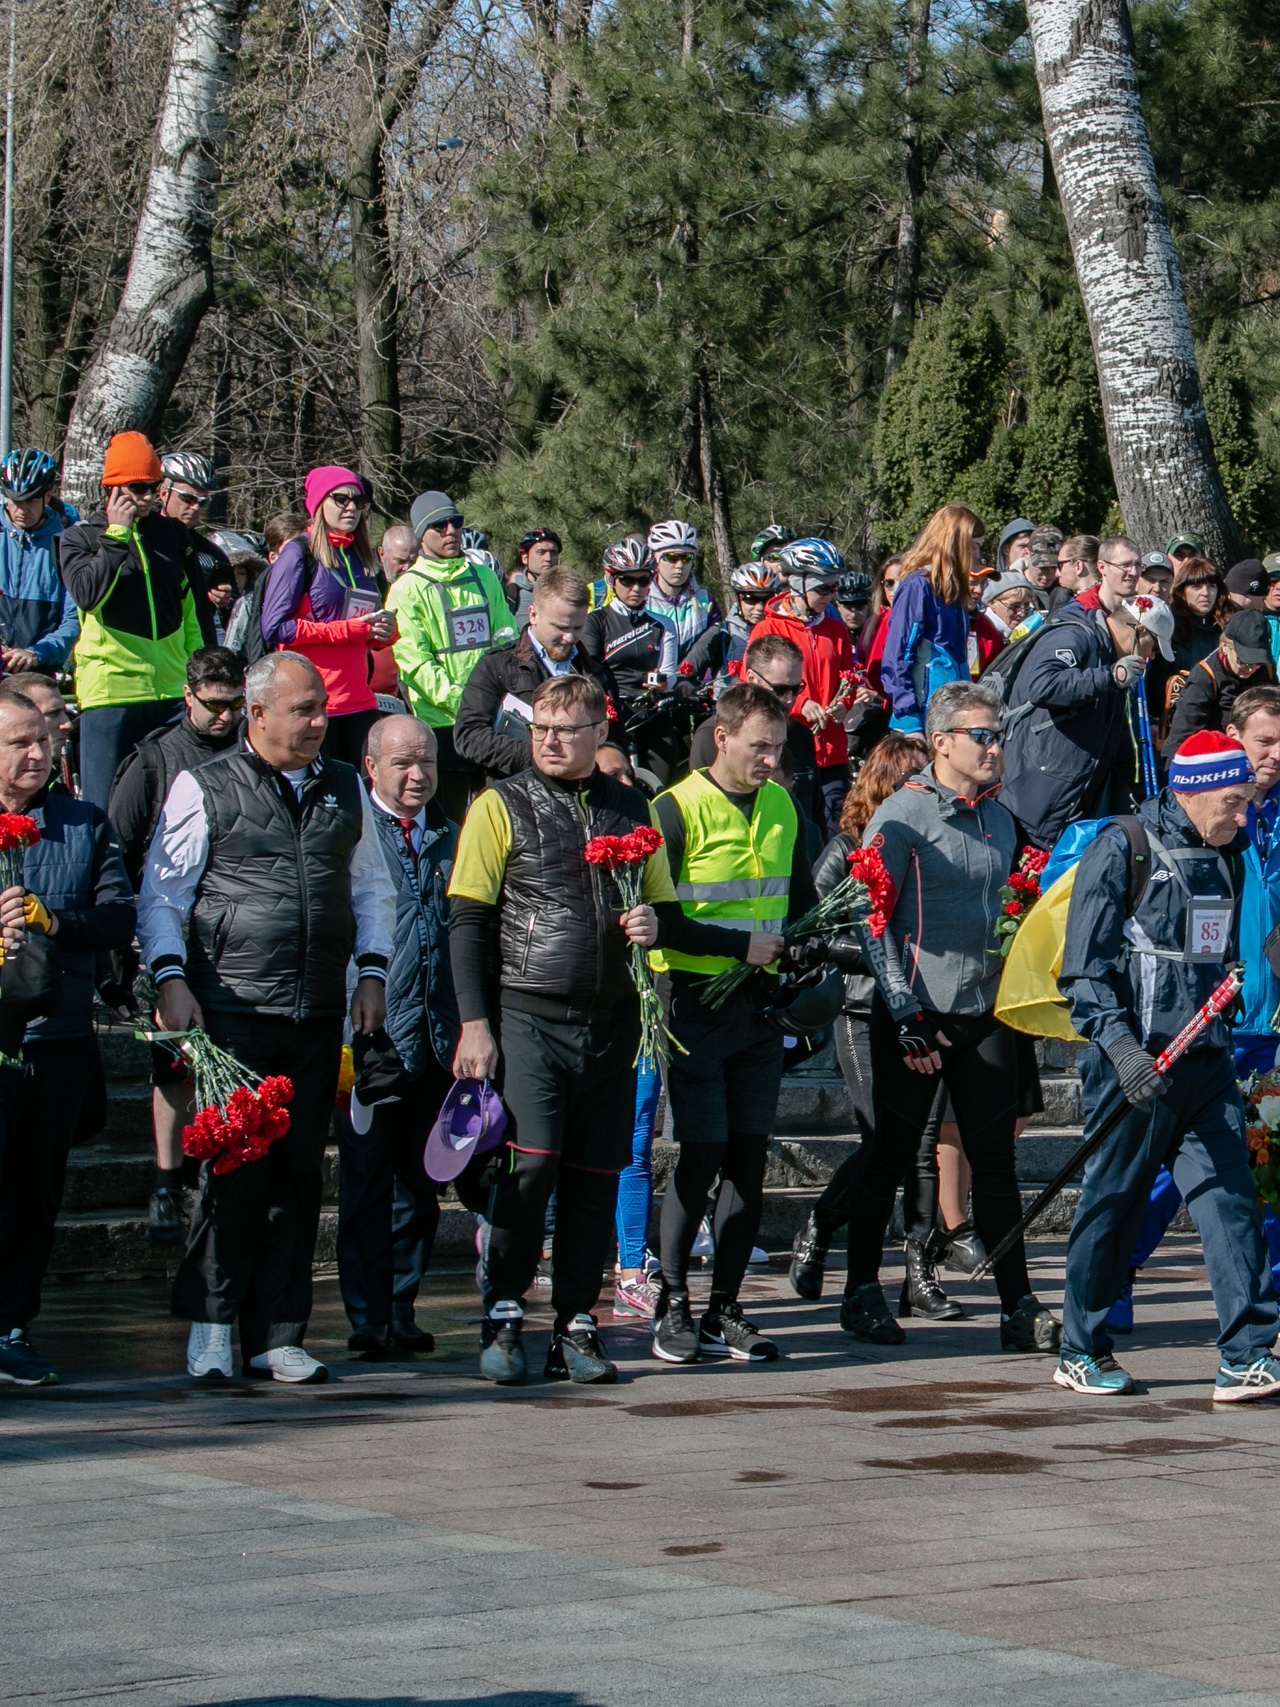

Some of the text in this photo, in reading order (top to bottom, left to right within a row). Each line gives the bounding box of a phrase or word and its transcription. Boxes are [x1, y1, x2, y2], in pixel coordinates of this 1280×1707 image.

[455, 618, 485, 635] 328
[1173, 768, 1240, 784] ЛЫЖНЯ
[1201, 922, 1219, 941] 85
